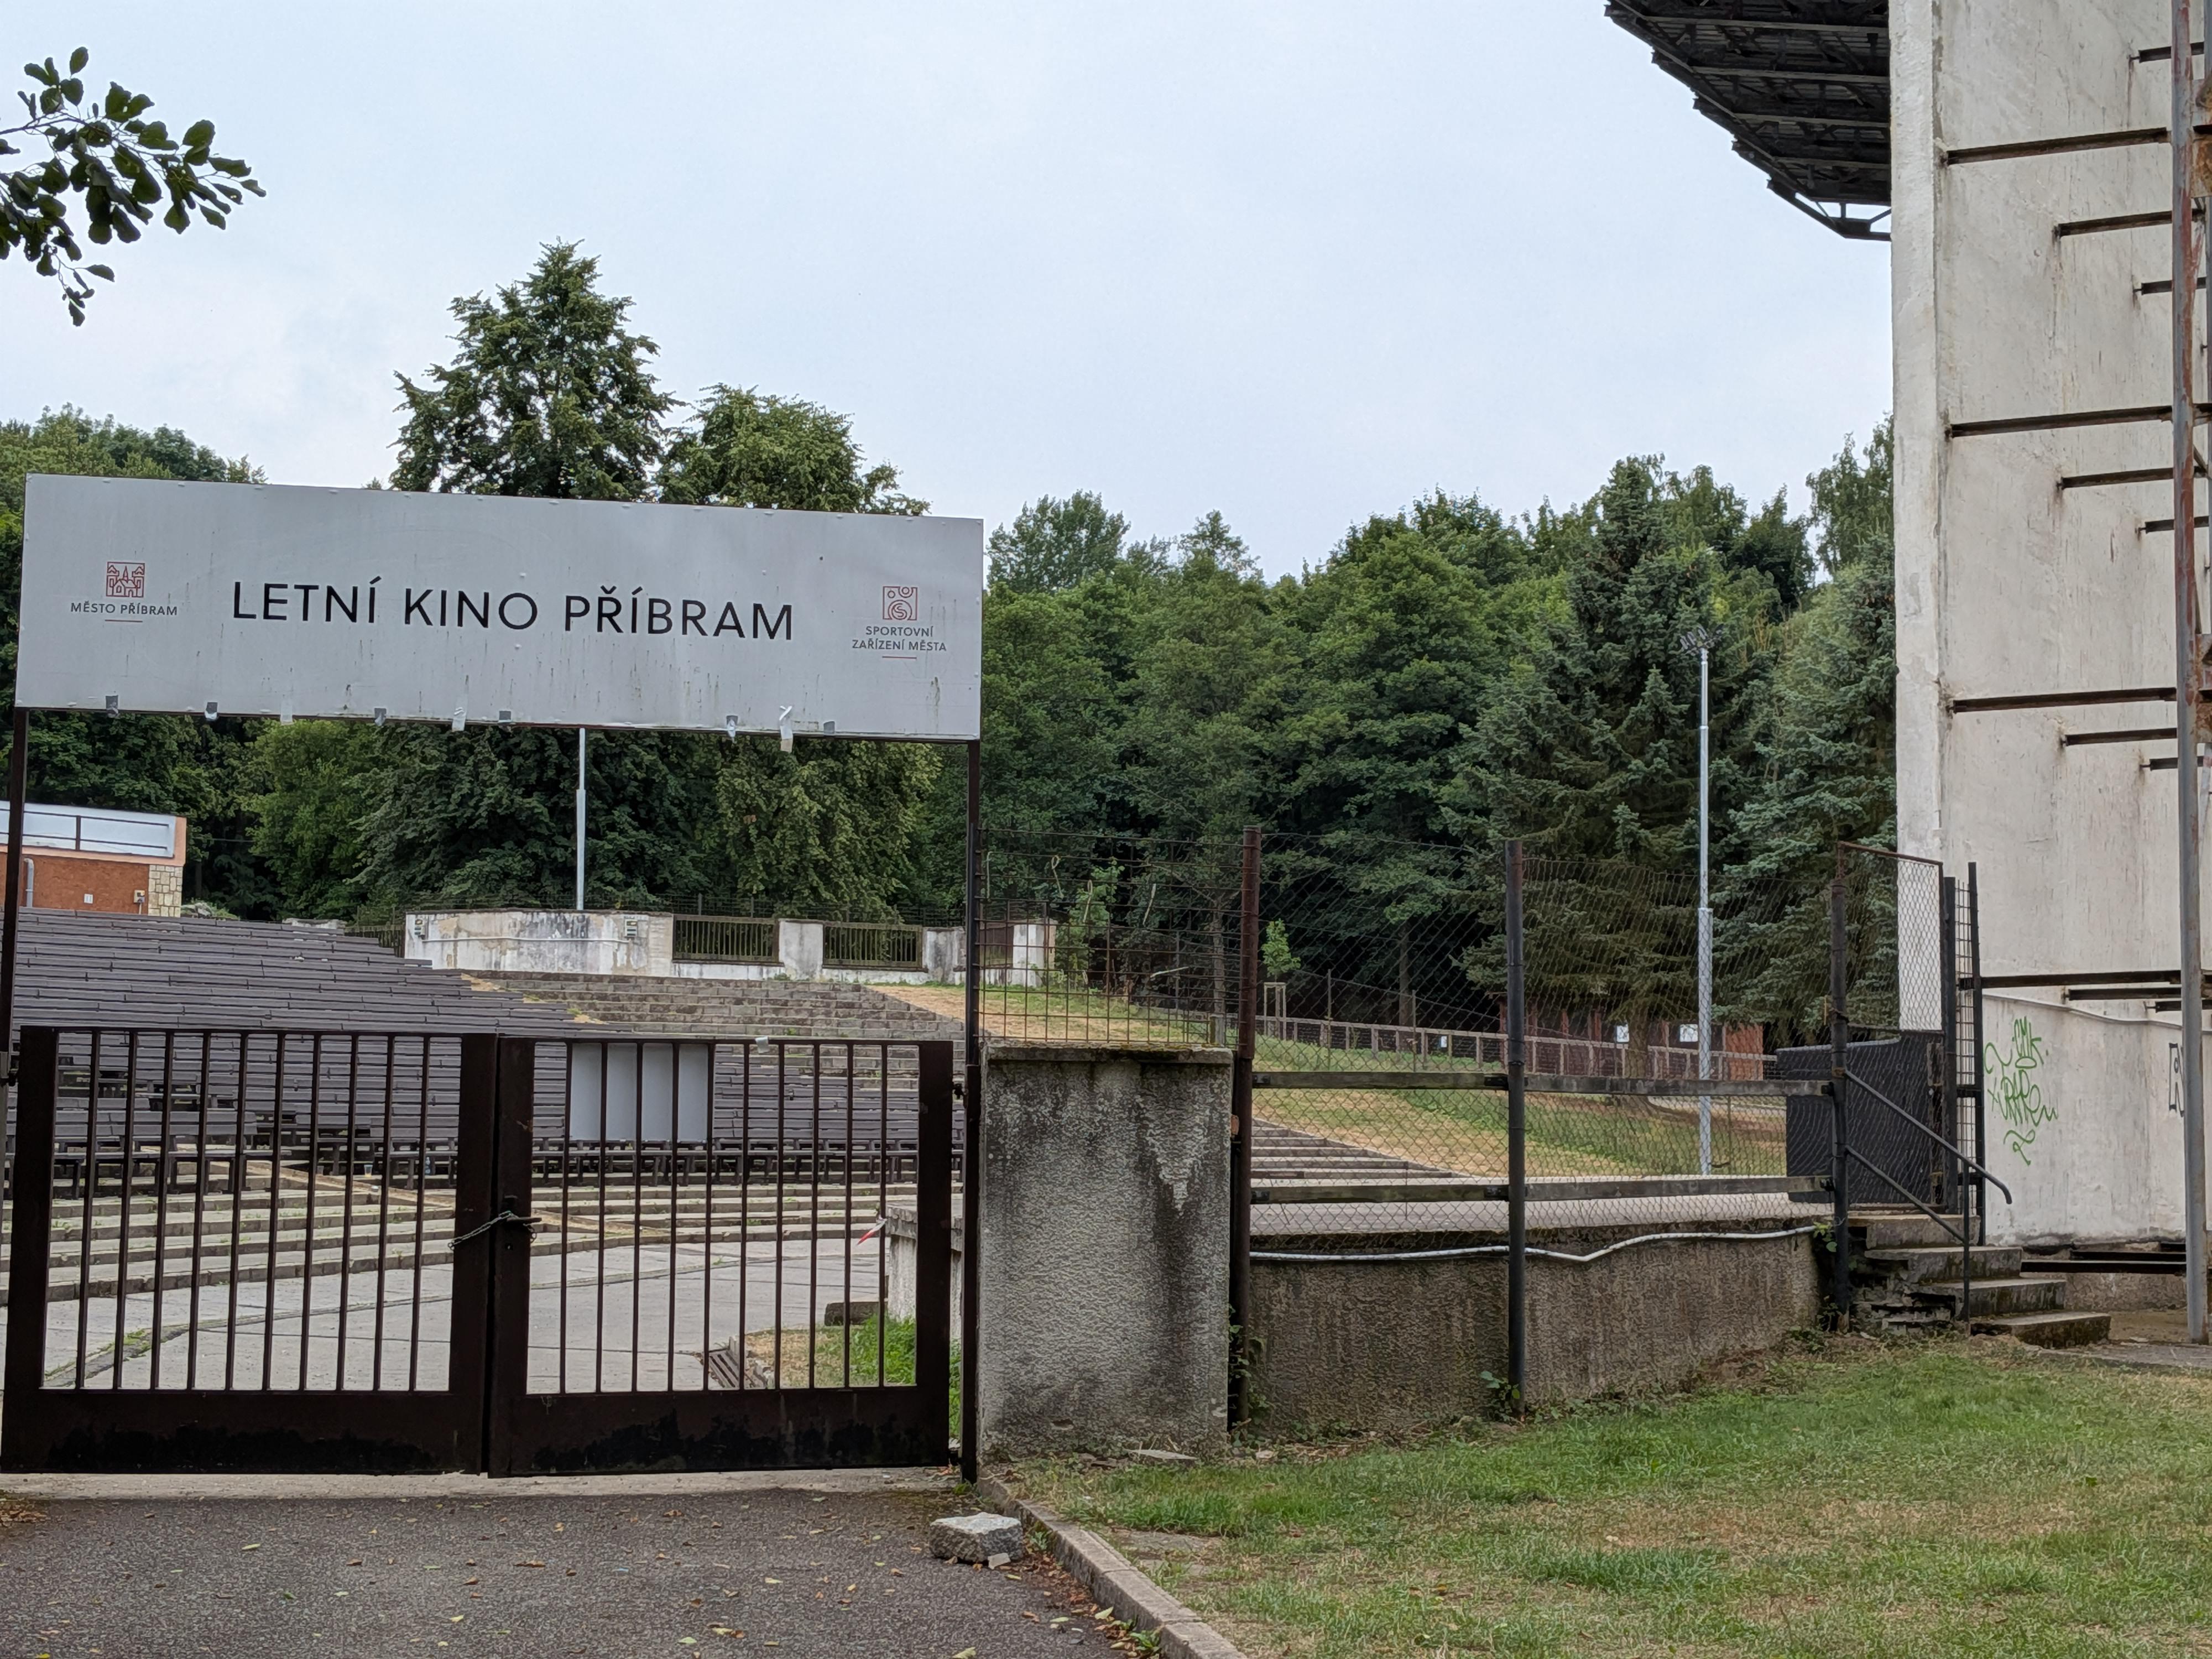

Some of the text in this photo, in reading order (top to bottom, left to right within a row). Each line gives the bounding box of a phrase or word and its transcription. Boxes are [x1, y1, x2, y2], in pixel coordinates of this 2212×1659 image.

[70, 600, 178, 615] MĚSTO PŘÍBRAM
[233, 576, 792, 640] LETNÍ KINO PŘÍBRAM
[865, 625, 934, 637] SPORTOVNÍ
[852, 638, 947, 651] ZAŘÍZENÍ MĚSTA
